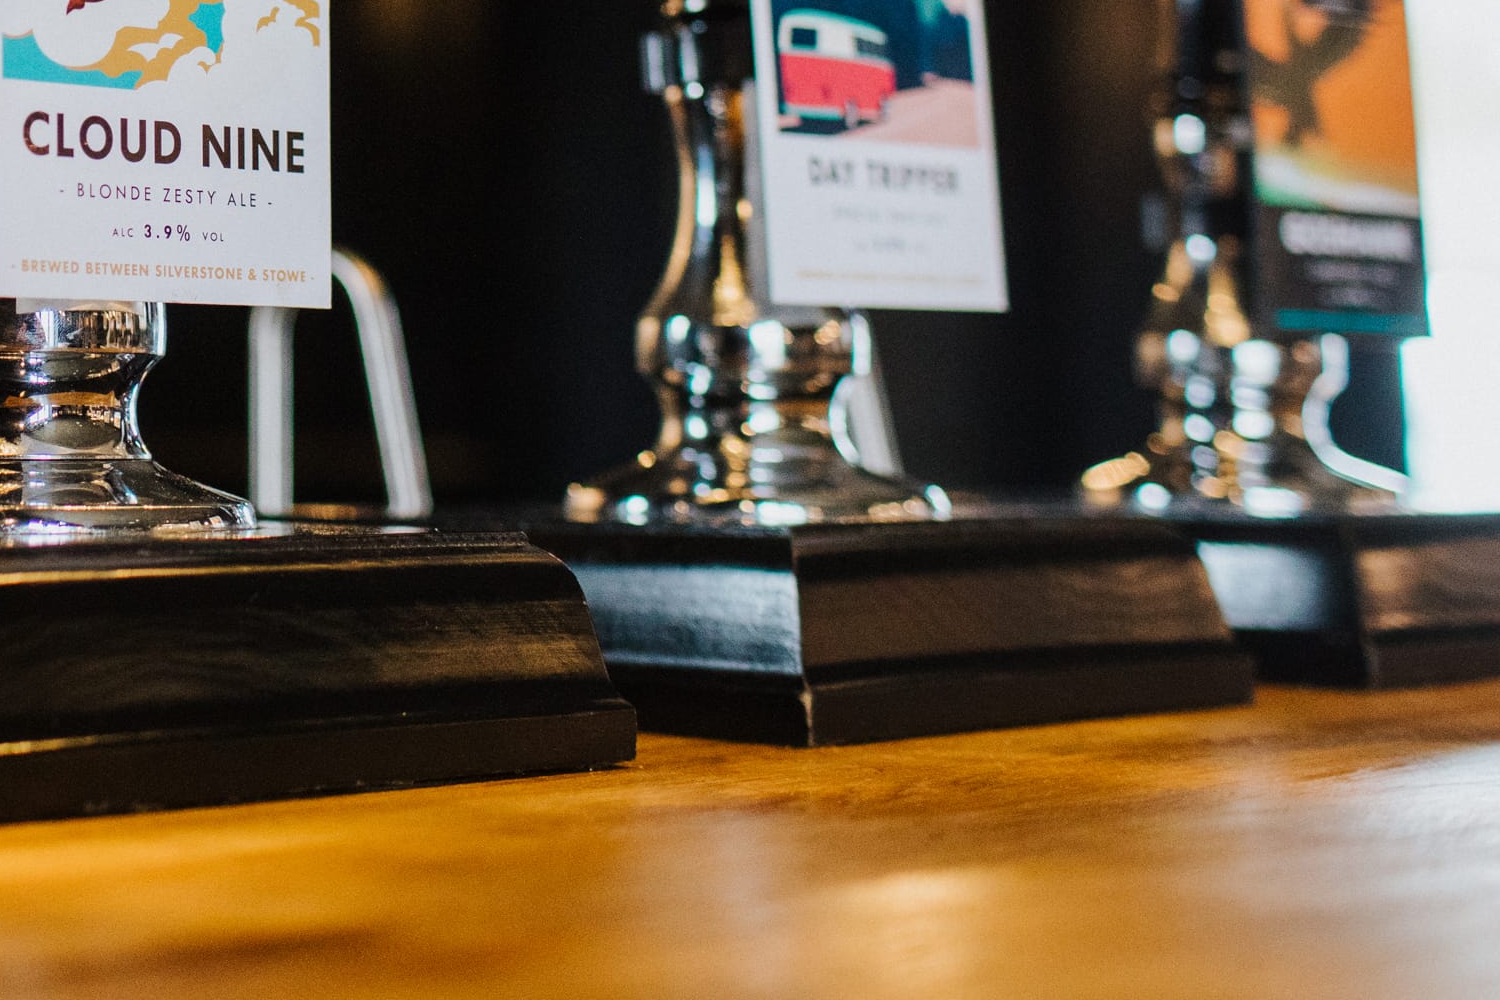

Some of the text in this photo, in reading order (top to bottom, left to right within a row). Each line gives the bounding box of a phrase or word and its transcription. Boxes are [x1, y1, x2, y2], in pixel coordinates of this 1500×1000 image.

[22, 110, 305, 174] CLOUD NINE
[808, 154, 854, 185] DAY
[76, 182, 257, 208] BLONDE ZESTY ALE
[112, 224, 224, 242] ALC 3.9% VOL
[21, 259, 306, 282] BREWED BETWEEN SILVERSTONE & STOWE
